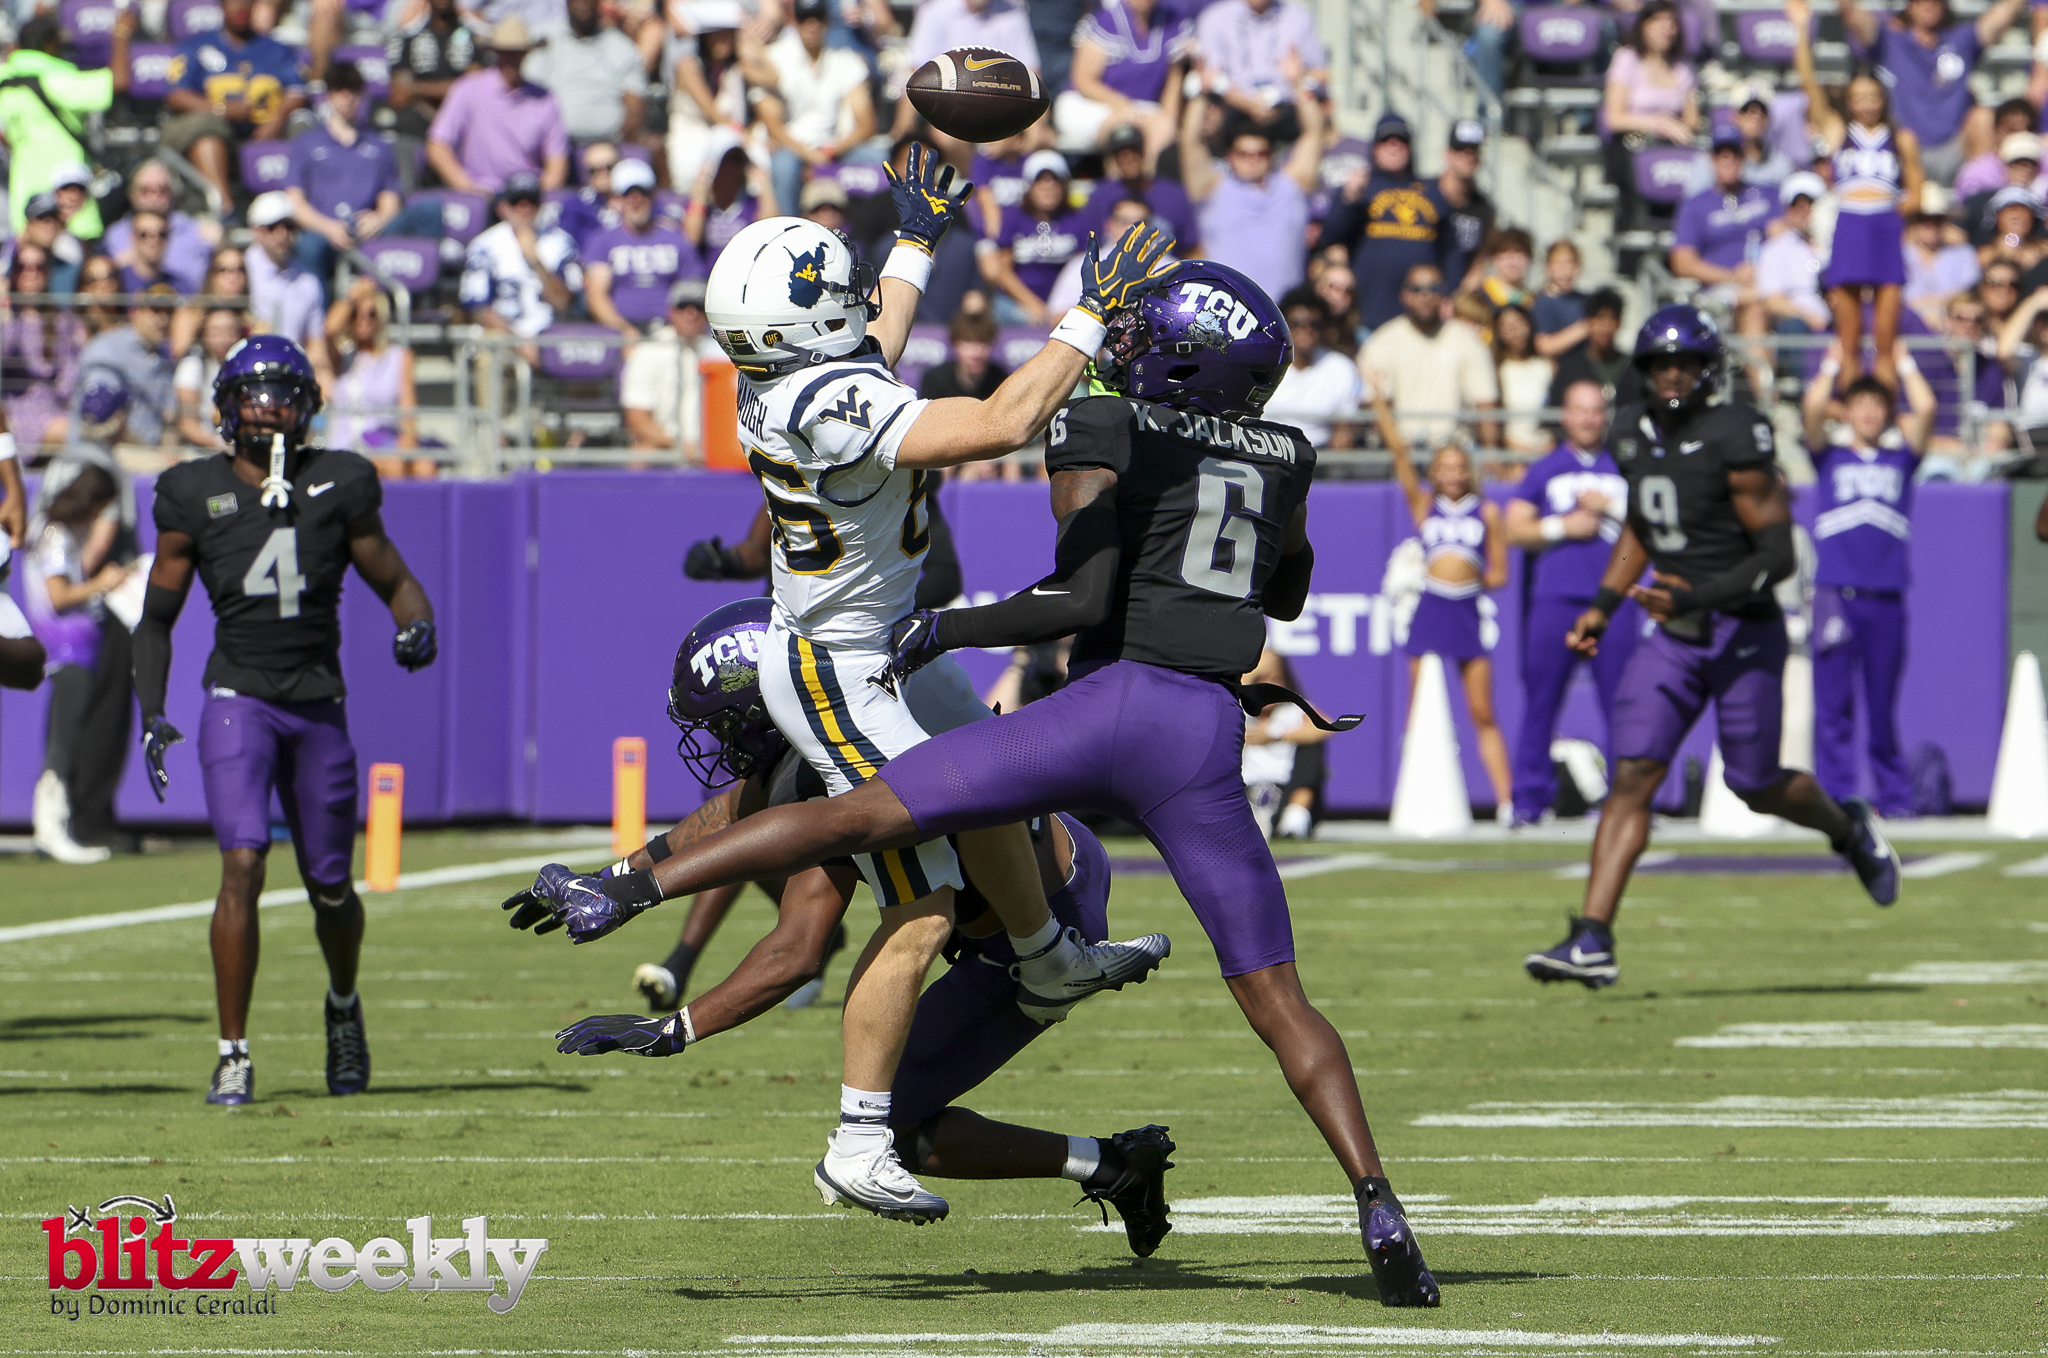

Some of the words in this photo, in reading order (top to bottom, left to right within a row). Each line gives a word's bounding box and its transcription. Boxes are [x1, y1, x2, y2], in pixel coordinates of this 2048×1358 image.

[1178, 282, 1259, 341] TCU
[1050, 407, 1069, 446] 6
[1130, 402, 1168, 432] K.
[1176, 411, 1297, 464] JACKSON
[1182, 457, 1265, 599] 6
[1638, 474, 1689, 552] 9
[243, 526, 308, 619] 4
[690, 628, 767, 688] TCU
